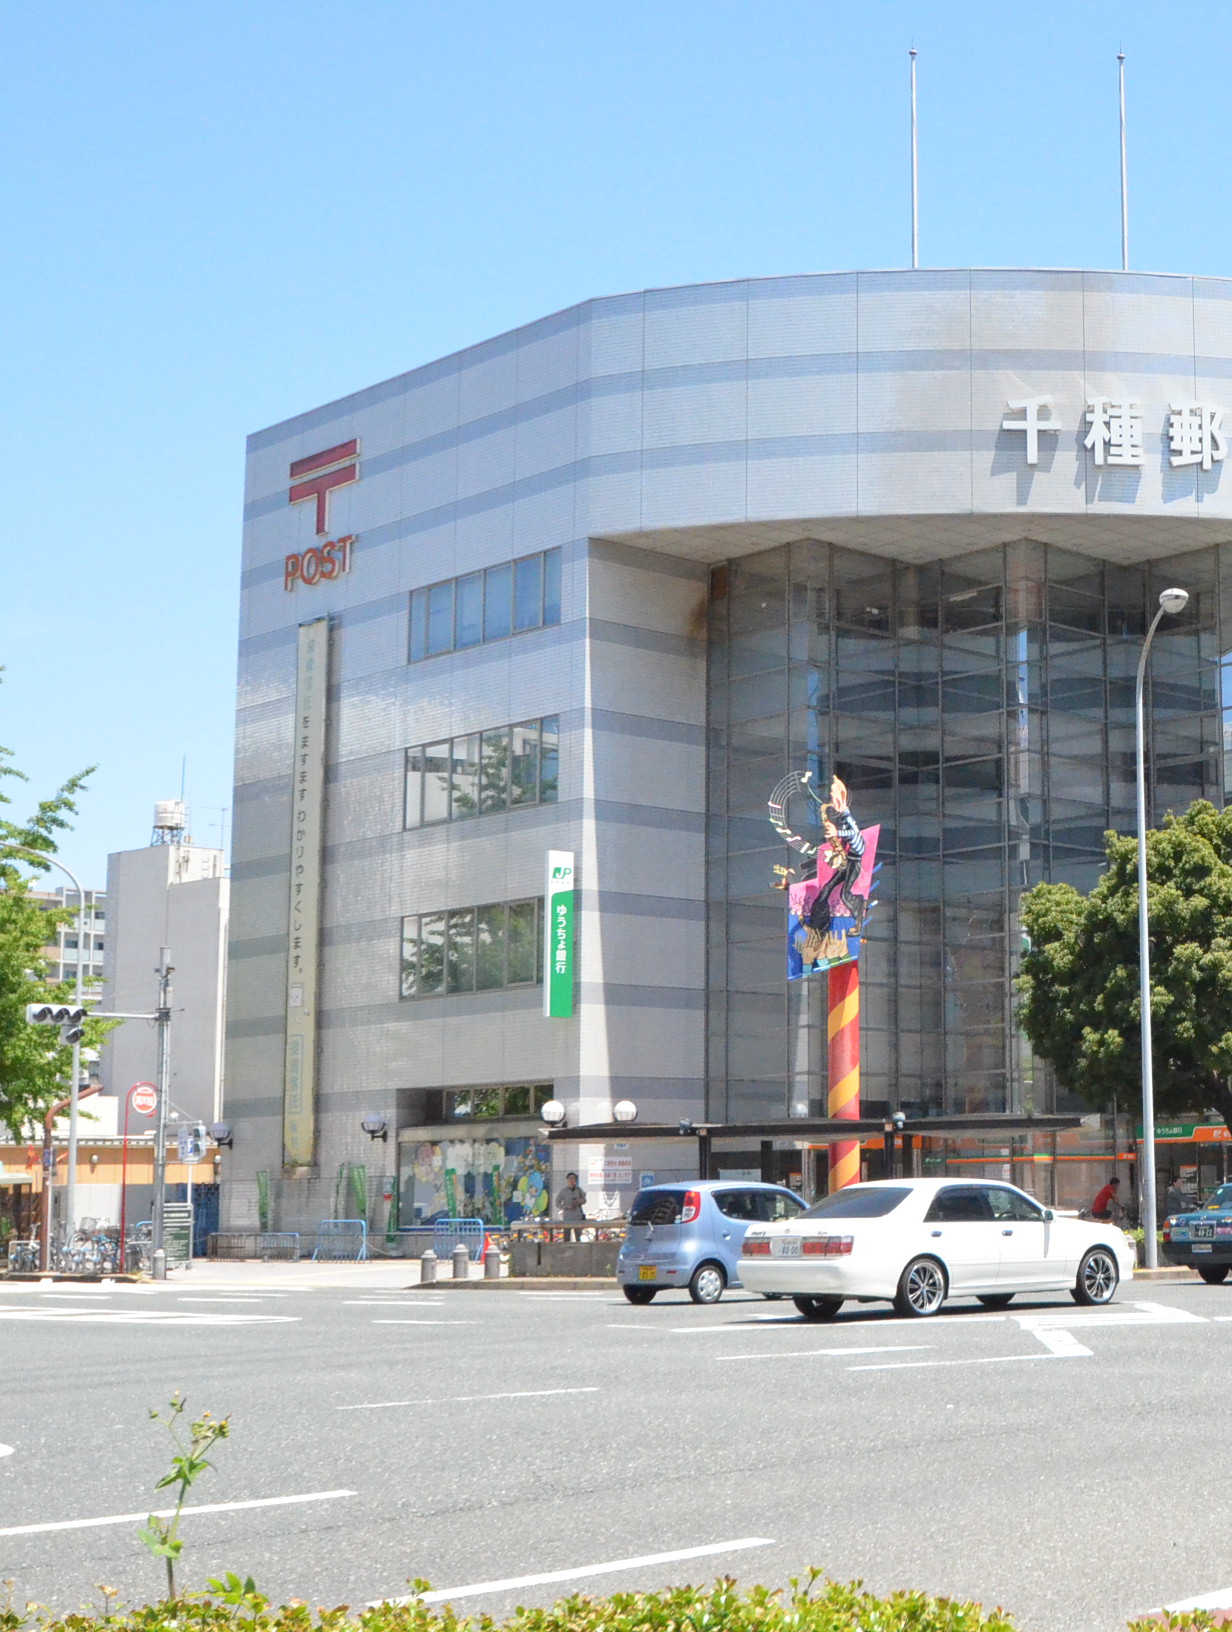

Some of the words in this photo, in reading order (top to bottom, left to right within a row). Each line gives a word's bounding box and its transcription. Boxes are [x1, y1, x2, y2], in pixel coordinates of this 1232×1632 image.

[284, 534, 357, 593] POST
[555, 903, 568, 975] ゆうちょ銀行
